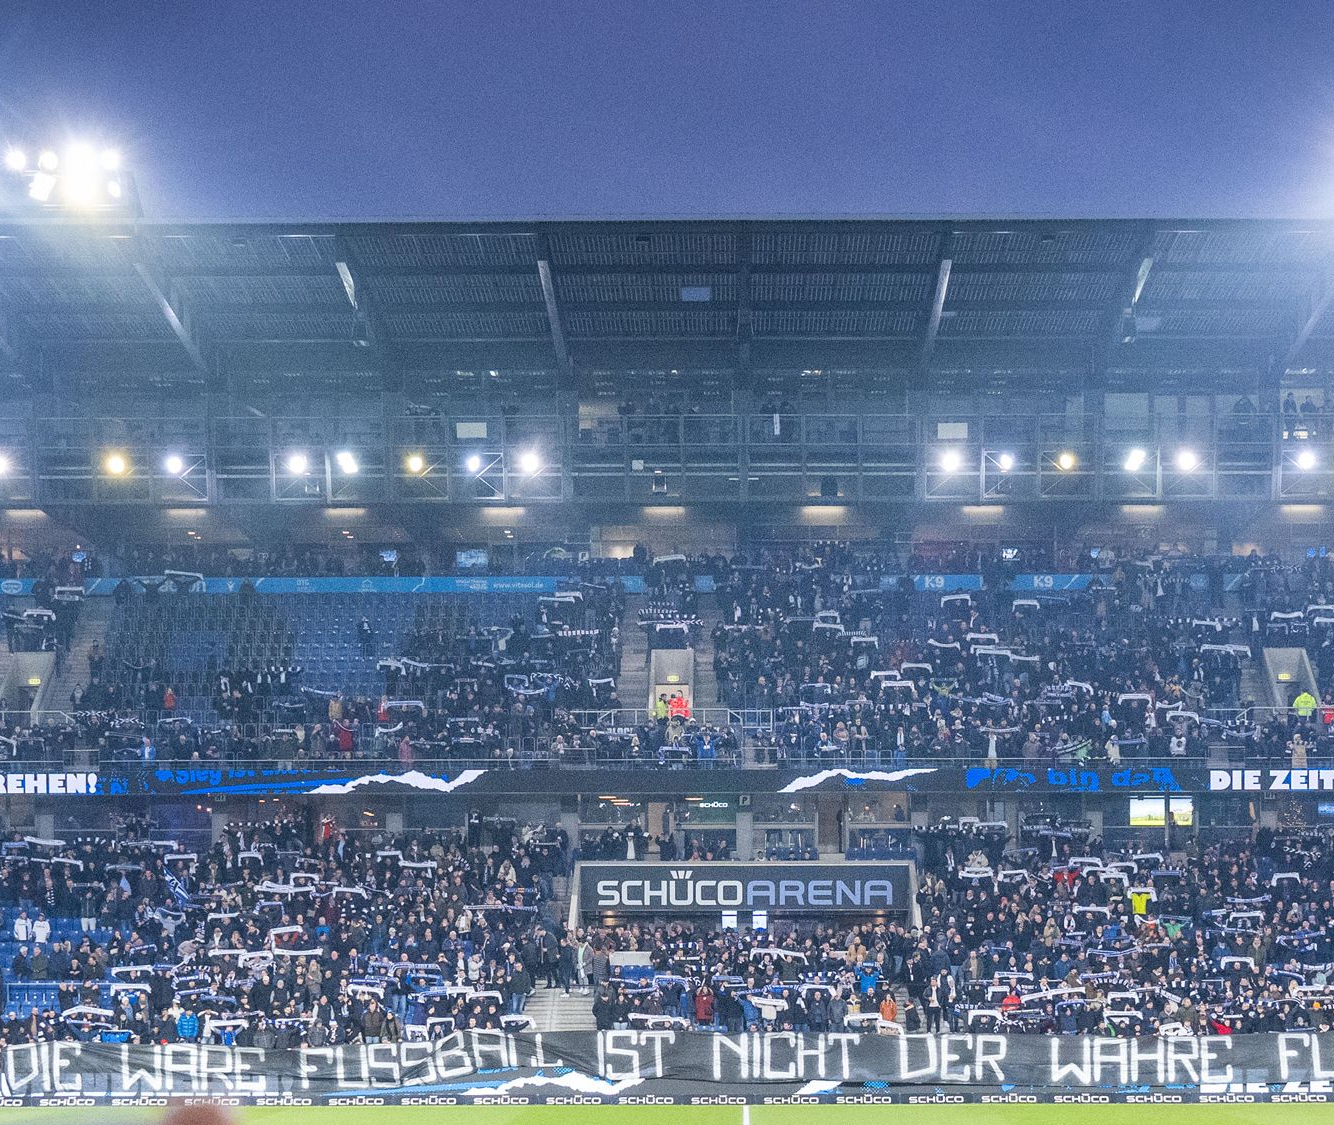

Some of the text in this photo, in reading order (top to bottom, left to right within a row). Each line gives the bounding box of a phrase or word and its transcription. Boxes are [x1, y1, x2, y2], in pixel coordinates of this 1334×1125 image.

[1209, 769, 1262, 791] DIE
[596, 870, 894, 906] SCHÜCOARENA
[6, 1041, 82, 1093] DIE
[598, 1030, 676, 1081] IST
[713, 1031, 860, 1081] NICHT
[898, 1033, 1008, 1081] DER
[1051, 1034, 1234, 1085] WAHRE
[39, 1096, 96, 1107] SCHÜCO
[111, 1096, 168, 1107] SCHÜCO
[255, 1096, 313, 1107] SCHÜCO
[328, 1095, 385, 1106] SCHÜCO
[401, 1095, 457, 1106] SCHÜCO
[473, 1095, 530, 1106] SCHÜCO
[545, 1095, 602, 1106] SCHÜCO
[618, 1094, 674, 1105] SCHÜCO
[690, 1094, 747, 1105] SCHÜCO
[763, 1094, 820, 1105] SCHÜCO
[836, 1094, 892, 1105] SCHÜCO
[908, 1093, 965, 1104] SCHÜCO
[981, 1093, 1037, 1104] SCHÜCO
[1053, 1093, 1110, 1104] SCHÜCO
[1125, 1093, 1183, 1104] SCHÜCO
[1198, 1093, 1255, 1104] SCHÜCO
[1270, 1092, 1327, 1103] SCHÜCO
